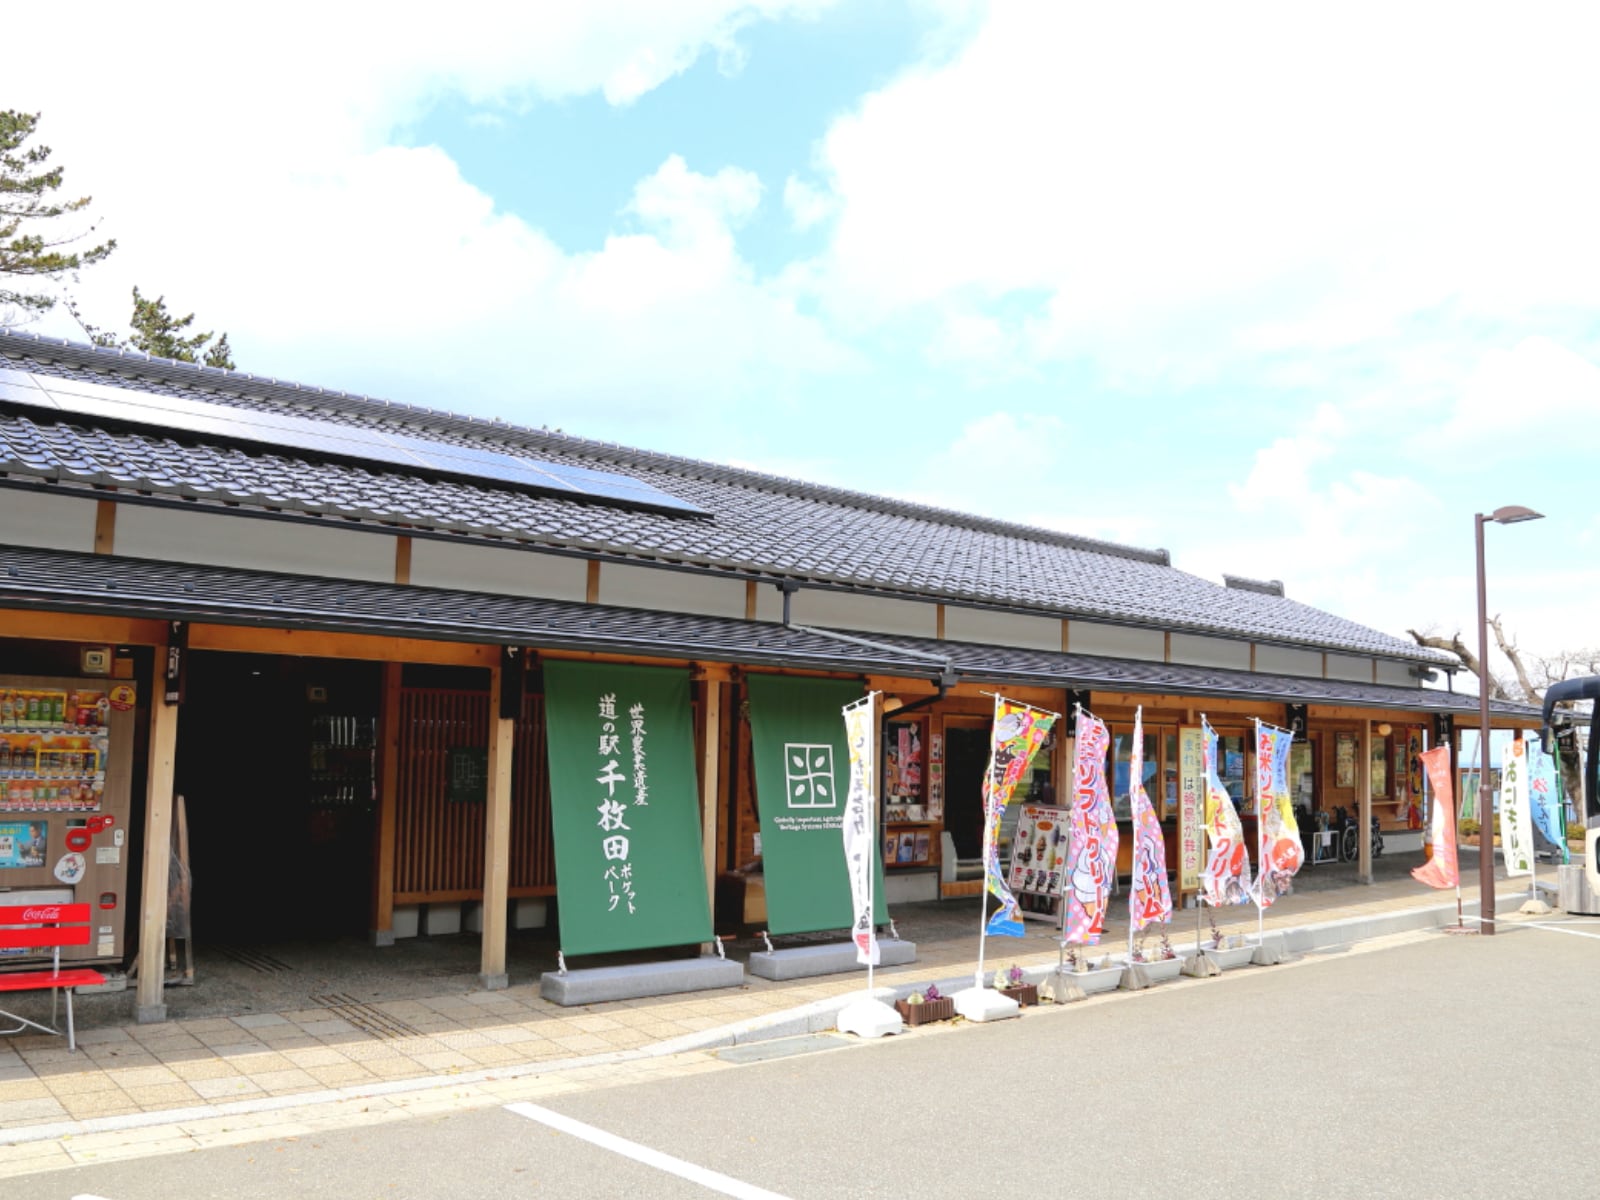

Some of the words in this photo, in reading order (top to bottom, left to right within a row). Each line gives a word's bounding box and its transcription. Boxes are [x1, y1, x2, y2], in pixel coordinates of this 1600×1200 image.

[629, 701, 650, 806] 世界農業遺産
[604, 865, 620, 912] パーク
[620, 862, 636, 915] ポケット
